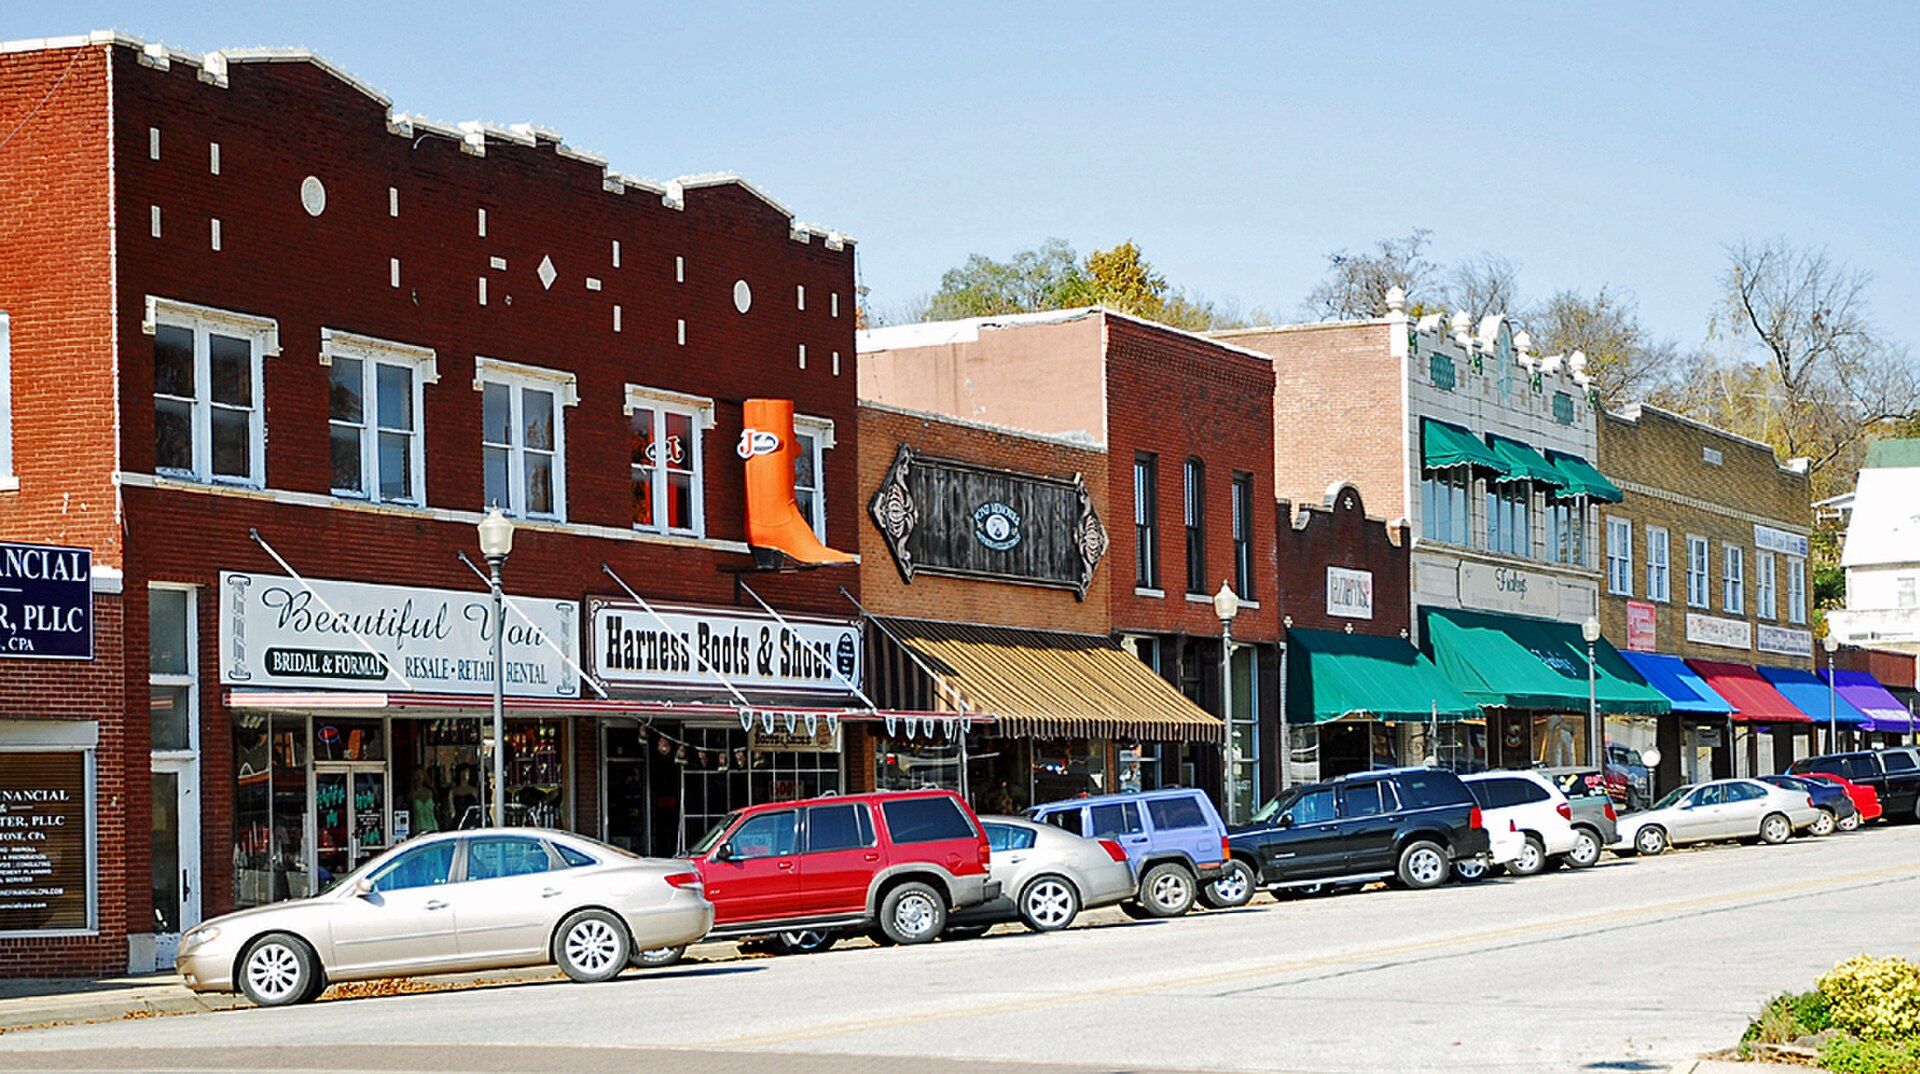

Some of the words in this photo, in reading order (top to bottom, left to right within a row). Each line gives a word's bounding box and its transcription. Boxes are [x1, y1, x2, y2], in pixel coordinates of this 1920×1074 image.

[0, 549, 87, 581] NCIAL
[24, 605, 83, 632] PLLC
[262, 587, 452, 650] Beautiful
[8, 637, 34, 650] CPA
[606, 616, 689, 672] Harness
[698, 622, 749, 675] Boots
[757, 626, 773, 676] &
[780, 627, 831, 678] Shoes
[273, 652, 320, 672] BRIDAL
[322, 656, 332, 673] &
[335, 655, 384, 676] FORMAL
[405, 657, 449, 679] RESALE
[506, 662, 548, 684] RENTAL
[32, 815, 65, 826] PLLC
